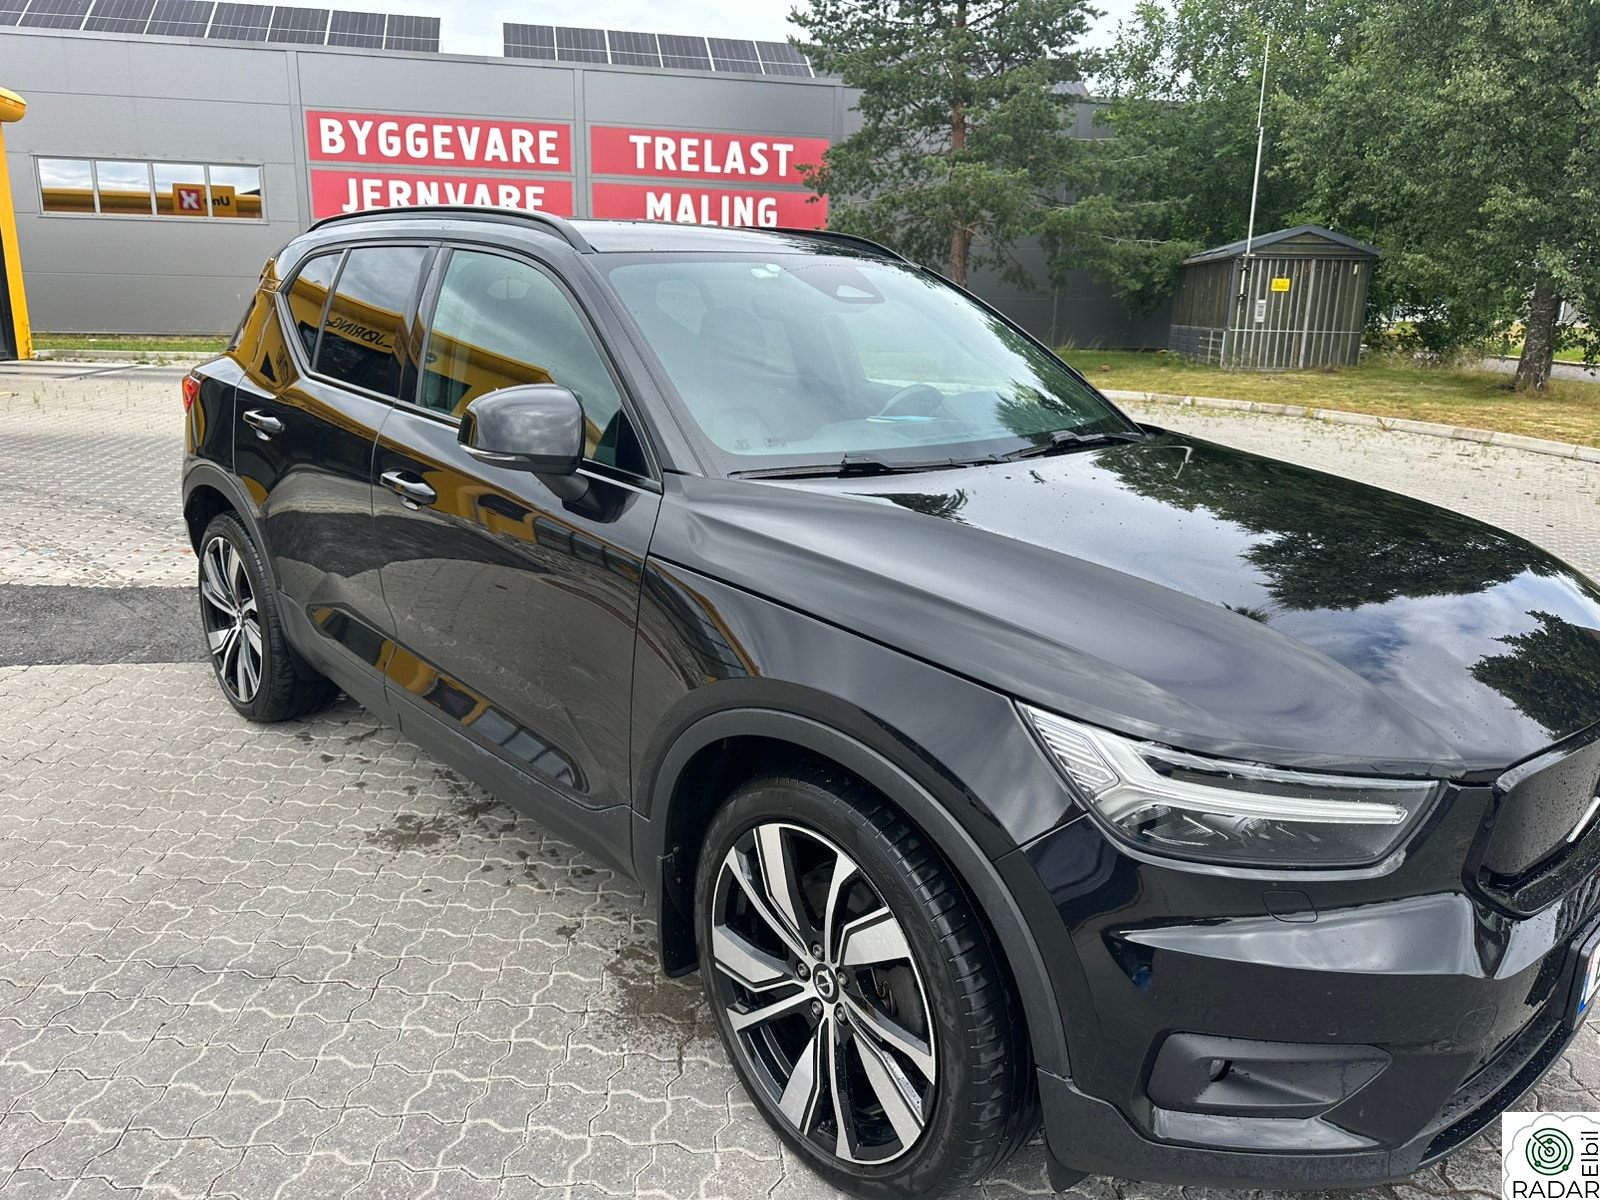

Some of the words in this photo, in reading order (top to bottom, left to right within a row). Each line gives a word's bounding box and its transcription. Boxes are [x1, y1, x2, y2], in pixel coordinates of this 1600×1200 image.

[319, 118, 560, 165] BYGGEVARE
[629, 135, 794, 176] TRELAST
[342, 178, 545, 213] JERNVARE
[646, 192, 777, 227] MALING
